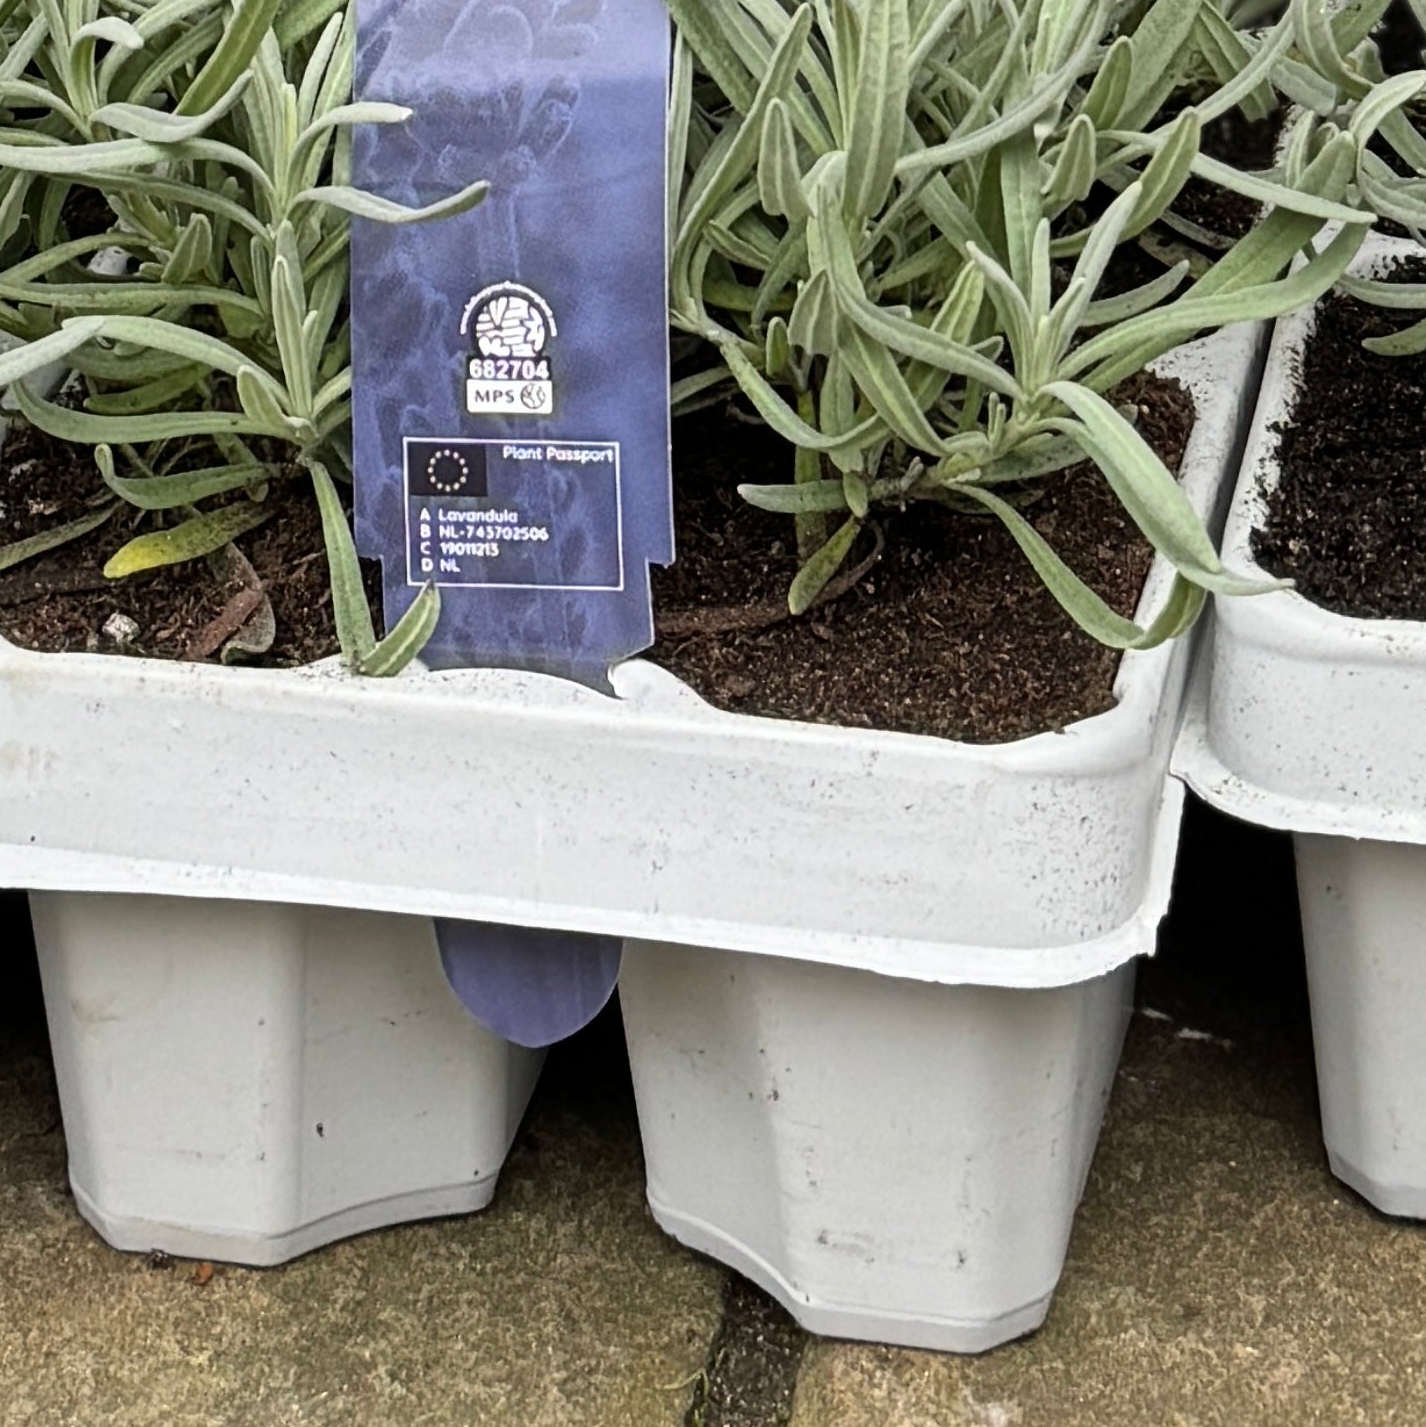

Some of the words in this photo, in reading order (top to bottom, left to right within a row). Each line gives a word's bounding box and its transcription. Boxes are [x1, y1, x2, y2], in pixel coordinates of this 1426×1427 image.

[469, 359, 549, 380] 682704
[474, 389, 515, 404] MPS
[503, 445, 542, 460] Plant
[546, 446, 614, 464] Passport
[420, 508, 431, 521] A
[438, 508, 519, 523] Lavandula
[420, 523, 431, 539] B
[420, 541, 431, 555] C
[421, 558, 433, 572] D
[439, 558, 461, 573] NL
